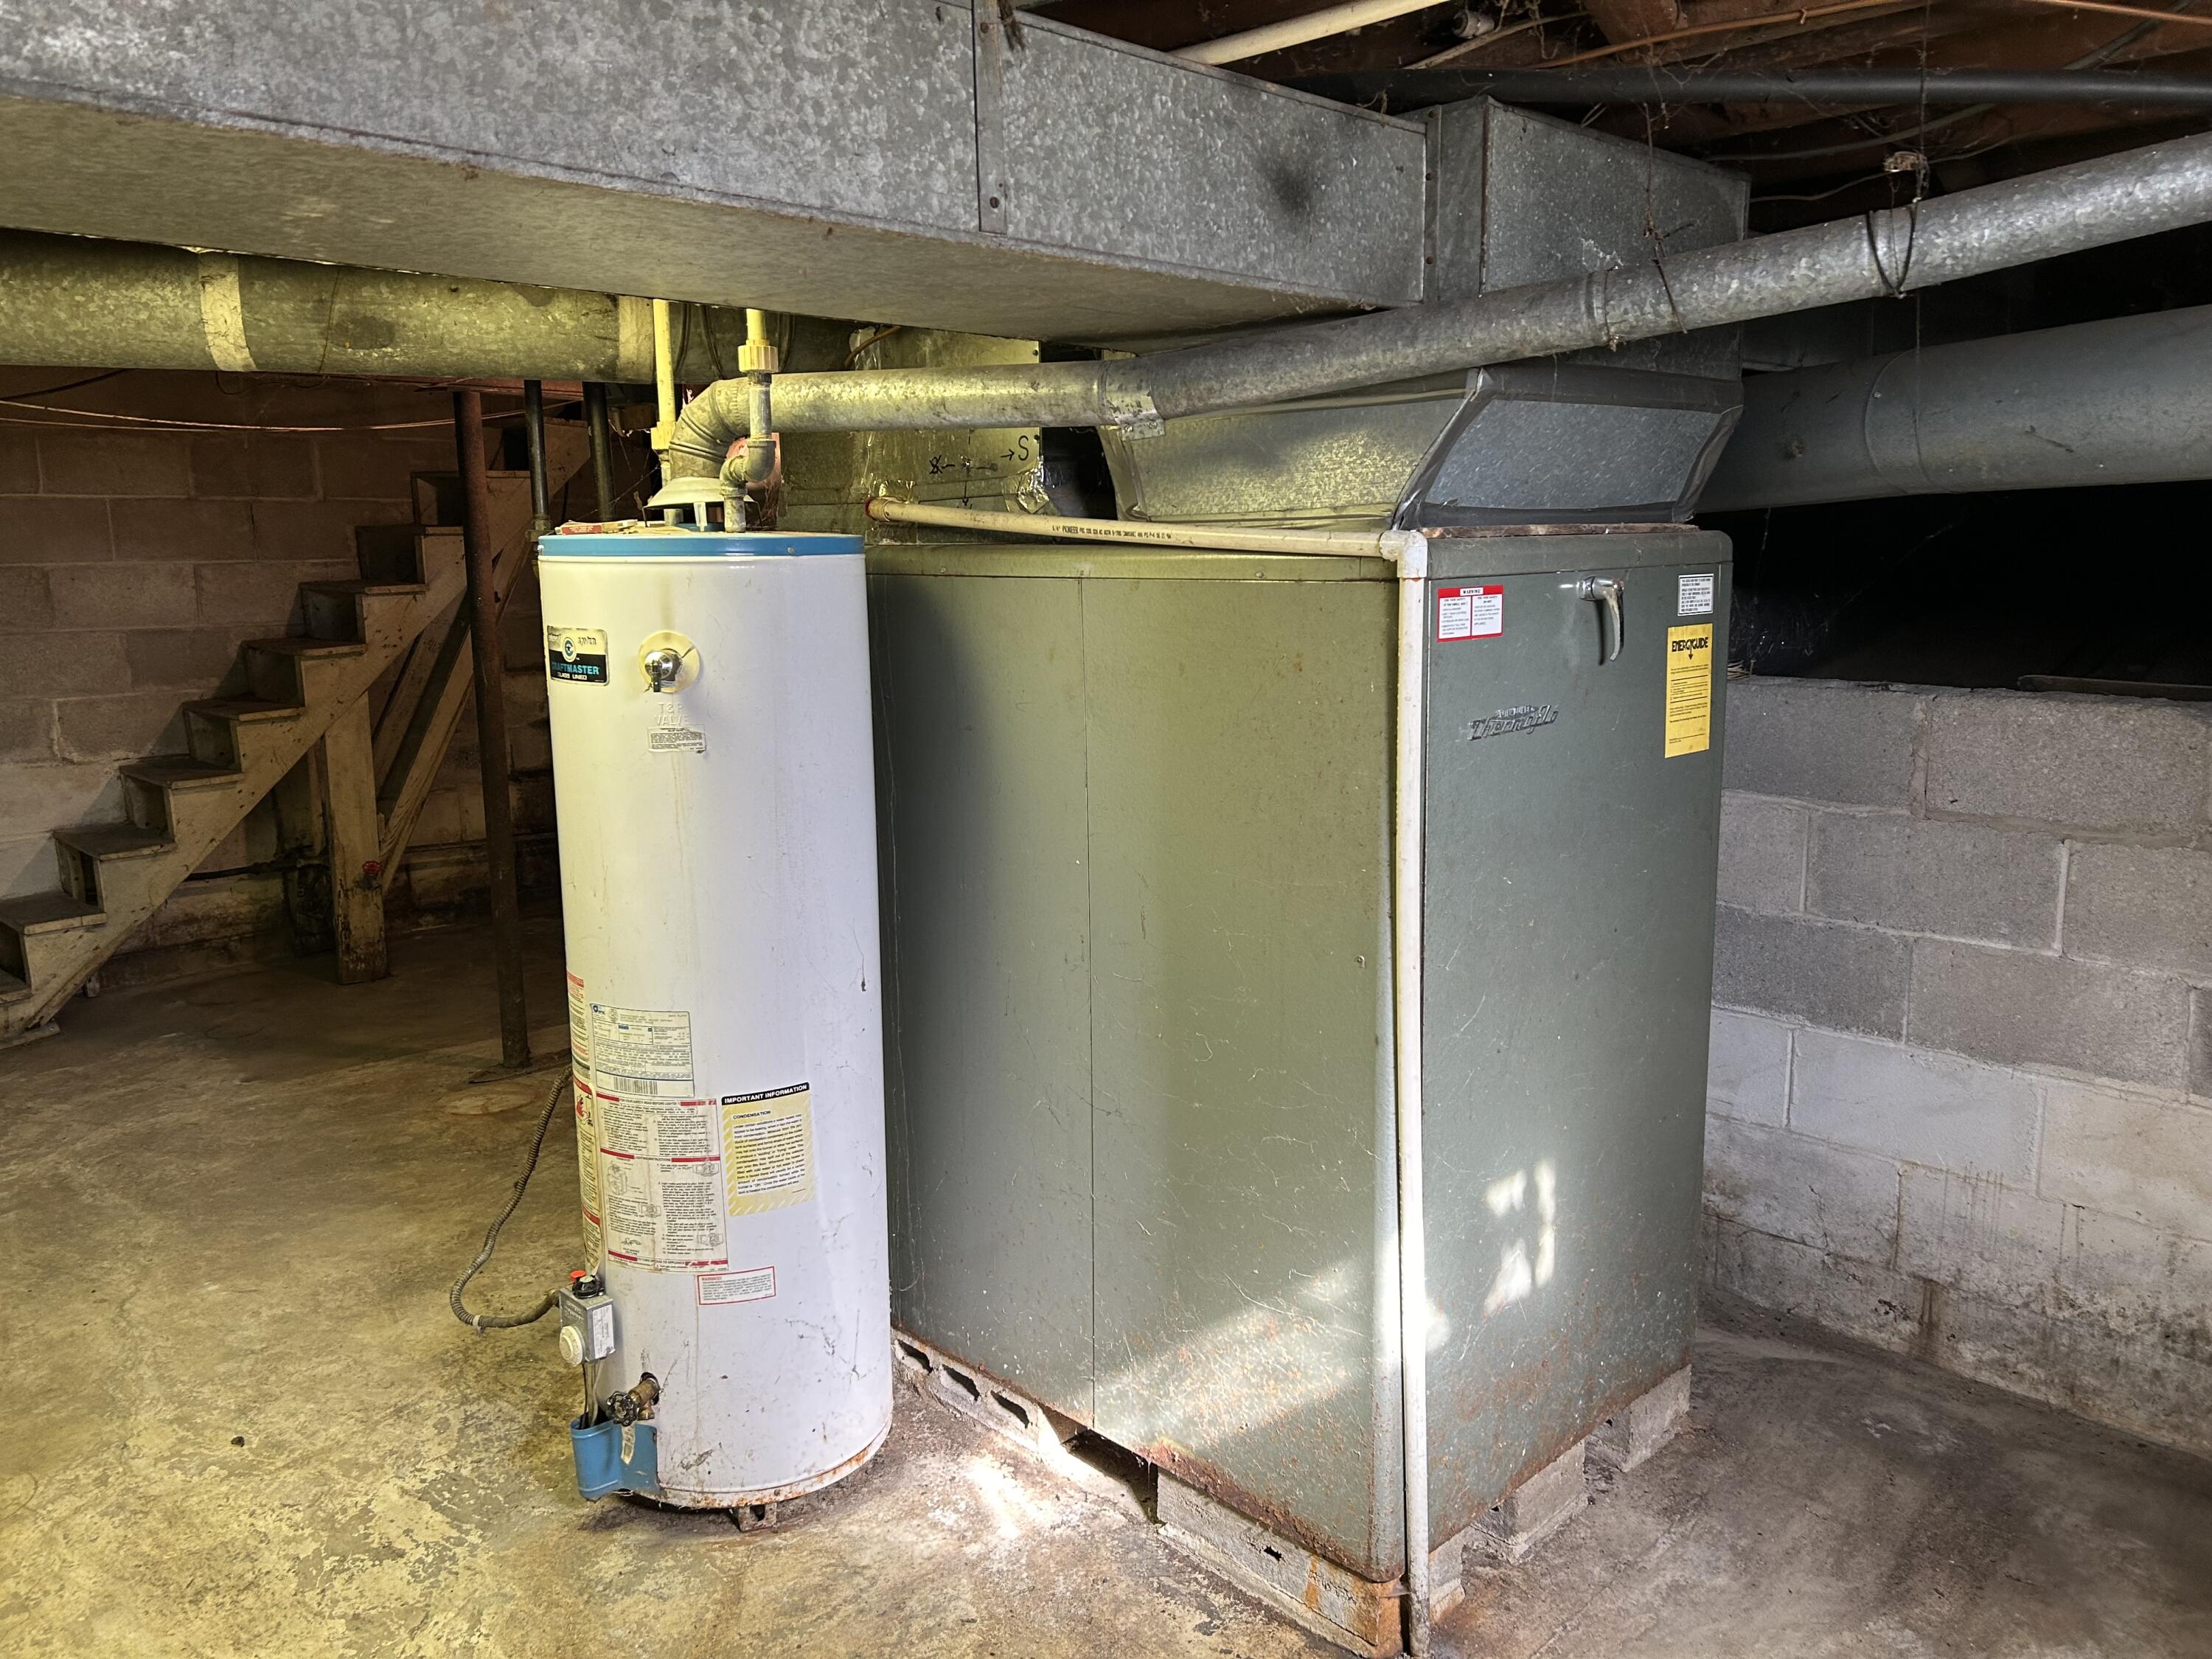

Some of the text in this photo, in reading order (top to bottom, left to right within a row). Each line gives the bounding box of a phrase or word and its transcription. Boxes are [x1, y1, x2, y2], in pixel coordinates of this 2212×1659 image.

[1018, 435, 1029, 462] S
[724, 1084, 807, 1104] IMPORTANT INFORMATION
[733, 1110, 771, 1119] CONDENSATION
